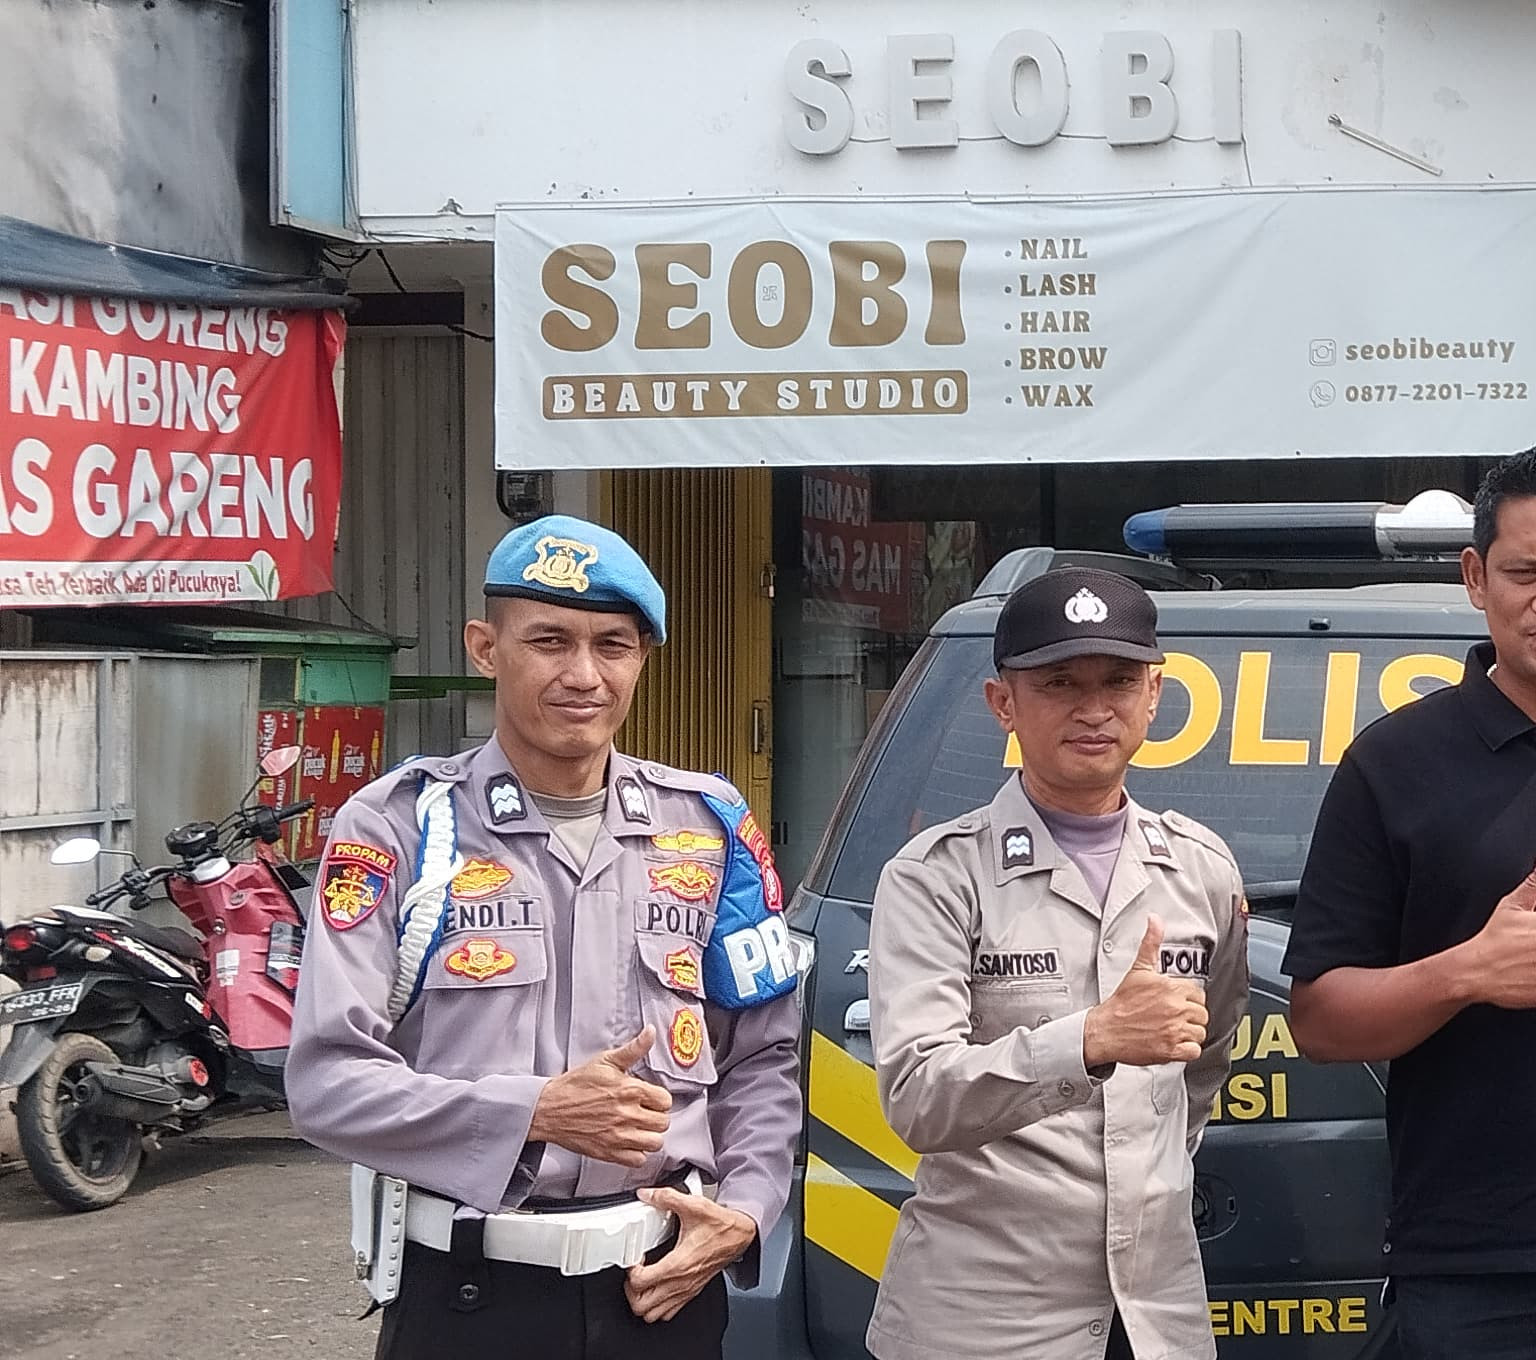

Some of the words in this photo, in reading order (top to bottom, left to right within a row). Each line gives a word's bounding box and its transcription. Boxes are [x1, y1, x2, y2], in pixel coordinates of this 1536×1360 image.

[783, 27, 1245, 155] SEOBI
[1019, 238, 1088, 260] NAIL
[539, 239, 967, 351] SEOBI
[1019, 273, 1098, 297] LASH
[1019, 310, 1091, 334] HAIR
[1019, 346, 1108, 371] BROW
[1344, 336, 1516, 366] seobibeauty
[9, 337, 242, 434] KAMBING
[552, 378, 749, 416] BEAUTY
[777, 376, 960, 412] STUDIO
[1021, 383, 1095, 407] WAX
[1344, 381, 1528, 404] 0877-2201-7322
[169, 569, 241, 598] Pucuknya!
[335, 844, 390, 868] PROPAM
